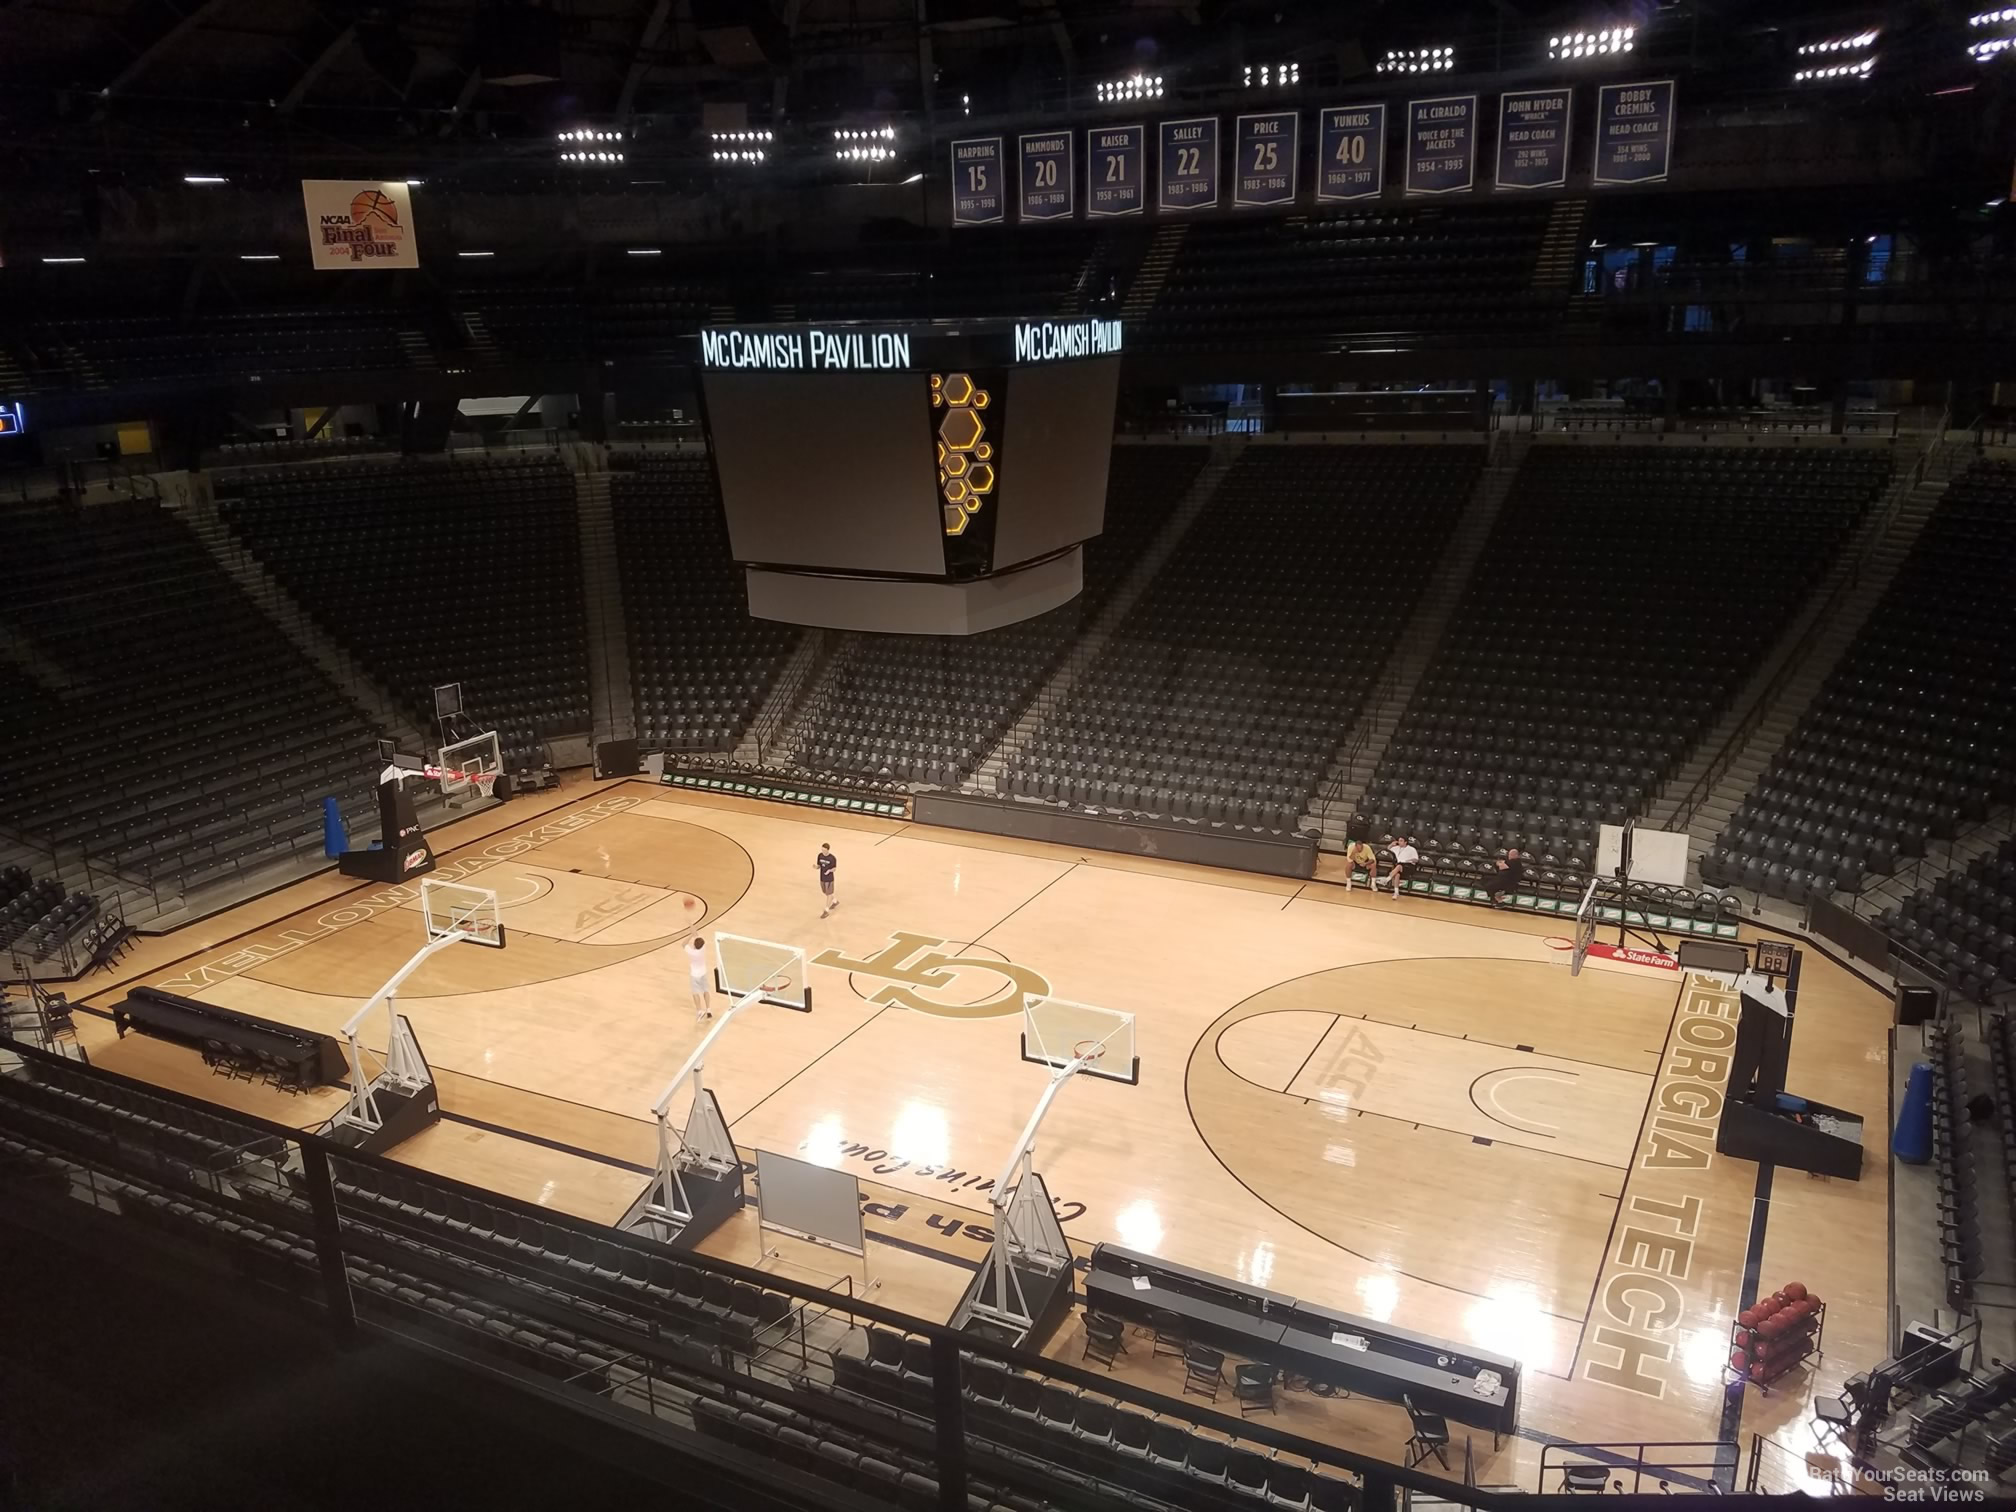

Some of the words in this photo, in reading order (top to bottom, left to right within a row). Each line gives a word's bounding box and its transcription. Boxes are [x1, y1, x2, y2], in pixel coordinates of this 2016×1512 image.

[1620, 90, 1652, 103] BOBBY
[1417, 108, 1428, 120] AL
[1430, 105, 1467, 119] CIRALDO
[1507, 100, 1531, 113] JOHN
[1533, 98, 1563, 111] HYDER
[1615, 102, 1656, 116] CREMINS
[1334, 113, 1370, 128] YUNKUS
[1173, 127, 1203, 140] SALLEY
[1254, 121, 1279, 135] PRICE
[1417, 130, 1438, 141] VOICE
[1440, 129, 1449, 139] OF
[1451, 128, 1465, 138] THE
[1609, 125, 1630, 135] HEAD
[1633, 122, 1659, 133] COACH
[1101, 134, 1129, 147] KAISER
[1509, 131, 1529, 142] HEAD
[1531, 130, 1556, 140] COACH
[958, 145, 995, 159] HARPRING
[1026, 140, 1064, 153] HAMMONDS
[1336, 135, 1365, 164] 40
[1426, 139, 1456, 151] JACKETS
[1177, 148, 1200, 176] 22
[1254, 143, 1278, 171] 25
[1035, 160, 1057, 187] 20
[1106, 155, 1125, 182] 21
[1417, 161, 1436, 173] 1954
[1444, 160, 1463, 171] 1993
[969, 166, 987, 191] 15
[1243, 179, 1261, 190] 1983
[1268, 178, 1286, 189] 1986
[1354, 172, 1371, 183] 1971
[1096, 190, 1112, 200] 1958
[1119, 189, 1134, 199] 1961
[1168, 184, 1184, 195] 1983
[1191, 183, 1208, 193] 1986
[320, 215, 351, 225] NCAA
[320, 225, 374, 245] Final
[329, 247, 350, 256] 2004
[350, 242, 398, 261] Four
[1091, 318, 1122, 354] PAVILION
[810, 331, 910, 369] PAVILION
[406, 824, 419, 835] PNC
[155, 885, 421, 988] YELLOW
[431, 796, 641, 883] JACKETS
[575, 887, 647, 929] ACC
[1627, 951, 1650, 964] State
[1651, 955, 1674, 968] Farm
[1326, 1031, 1385, 1101] ACC
[1584, 1195, 1703, 1400] TECH
